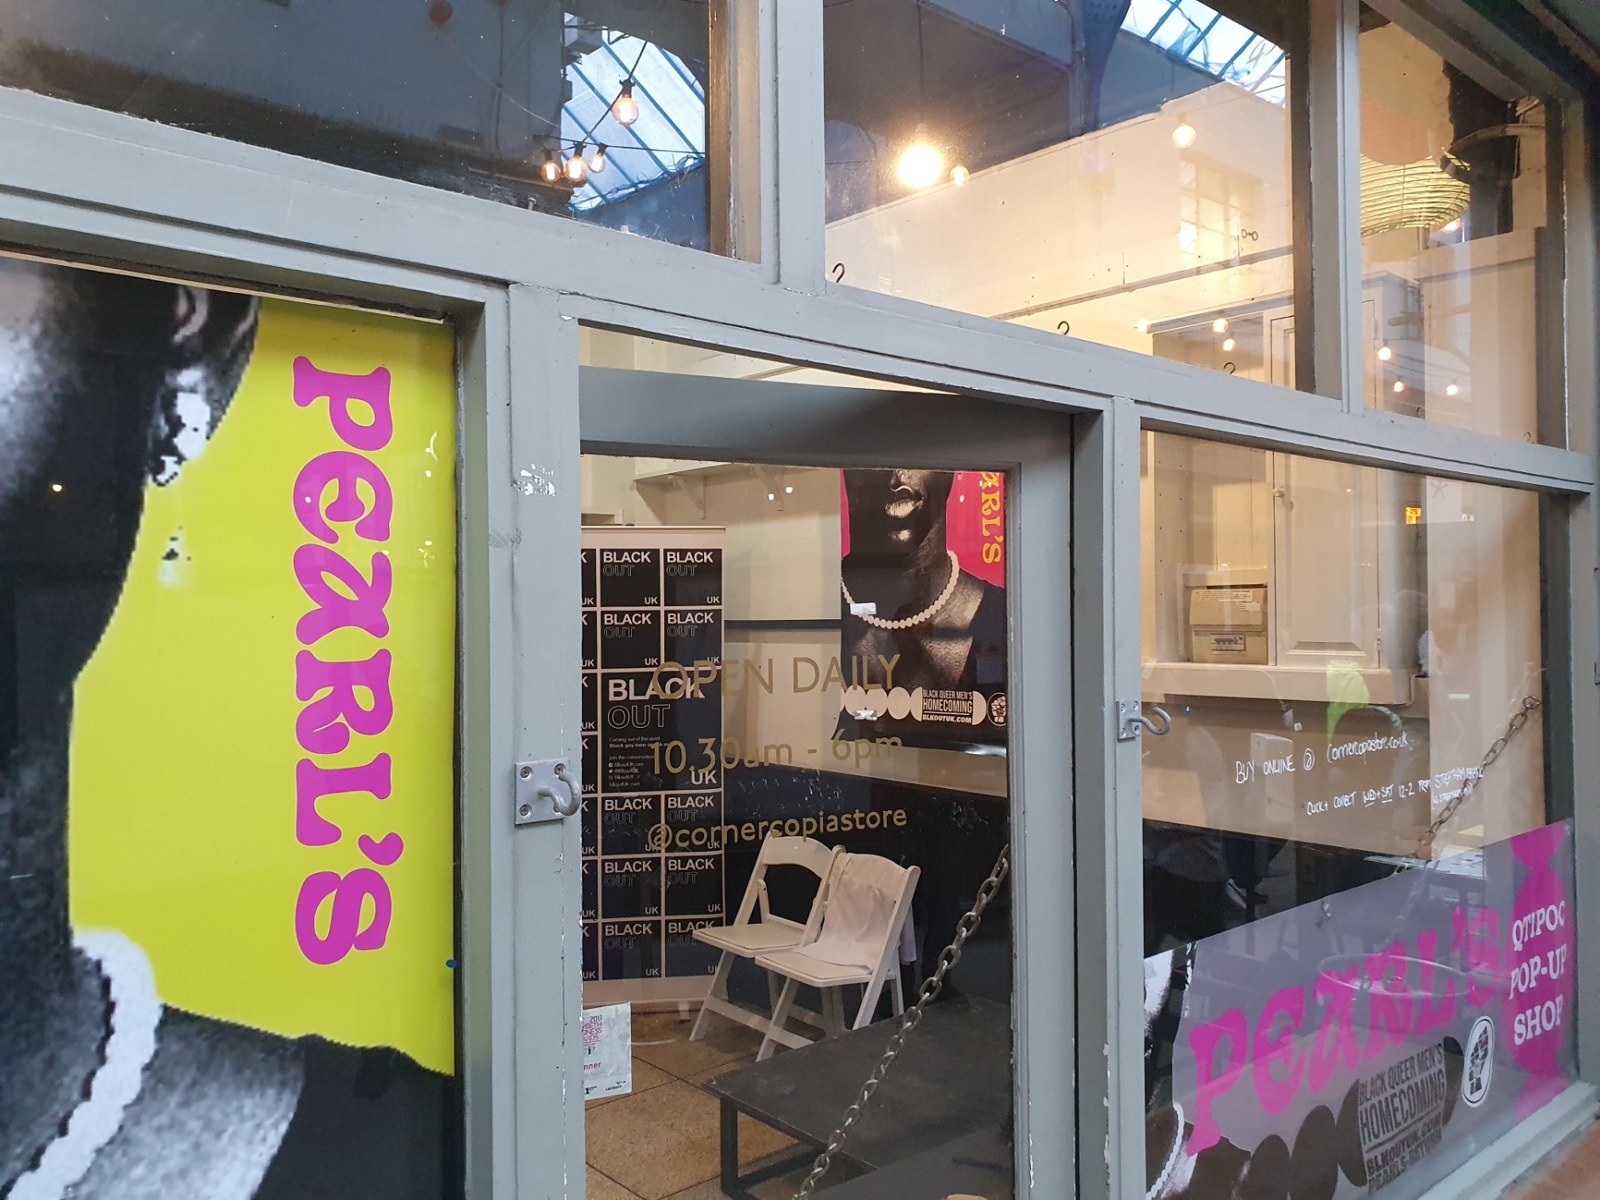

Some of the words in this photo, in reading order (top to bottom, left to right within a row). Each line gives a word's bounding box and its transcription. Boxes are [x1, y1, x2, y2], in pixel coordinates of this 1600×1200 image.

[981, 471, 1004, 564] ARL'S
[603, 551, 651, 563] BLACK
[666, 551, 714, 563] BLACK
[644, 596, 658, 605] UK
[706, 595, 720, 604] UK
[603, 613, 652, 625] BLACK
[667, 612, 714, 624] BLACK
[644, 657, 659, 666] UK
[653, 658, 774, 698] OPEN
[793, 654, 901, 693] DAILY
[608, 677, 705, 702] BLACK
[939, 690, 956, 699] QUEER
[922, 698, 973, 713] HOMECOMING
[607, 704, 671, 729] OUT
[922, 714, 972, 724] BLKOUTUK.COM
[832, 728, 903, 768] 6pm
[1263, 754, 1296, 776] ONLINE
[690, 769, 718, 785] UK
[605, 798, 652, 811] BLACK
[667, 795, 715, 808] BLACK
[647, 807, 908, 850] @cornercopiastore
[707, 841, 721, 850] UK
[604, 860, 652, 873] BLACK
[667, 858, 715, 871] BLACK
[644, 906, 659, 915] UK
[707, 903, 721, 912] UK
[605, 923, 652, 936] BLACK
[668, 920, 715, 934] BLACK
[1512, 900, 1566, 951] QTIPOC
[645, 968, 659, 976] UK
[1508, 943, 1567, 1001] POP-UP
[1513, 994, 1564, 1046] SHOP
[583, 1061, 602, 1071] nner
[1359, 1073, 1388, 1106] BLACK
[1387, 1055, 1416, 1090] QUEER
[1416, 1042, 1444, 1075] MEN'S
[1359, 1067, 1446, 1146] HOMECOMING
